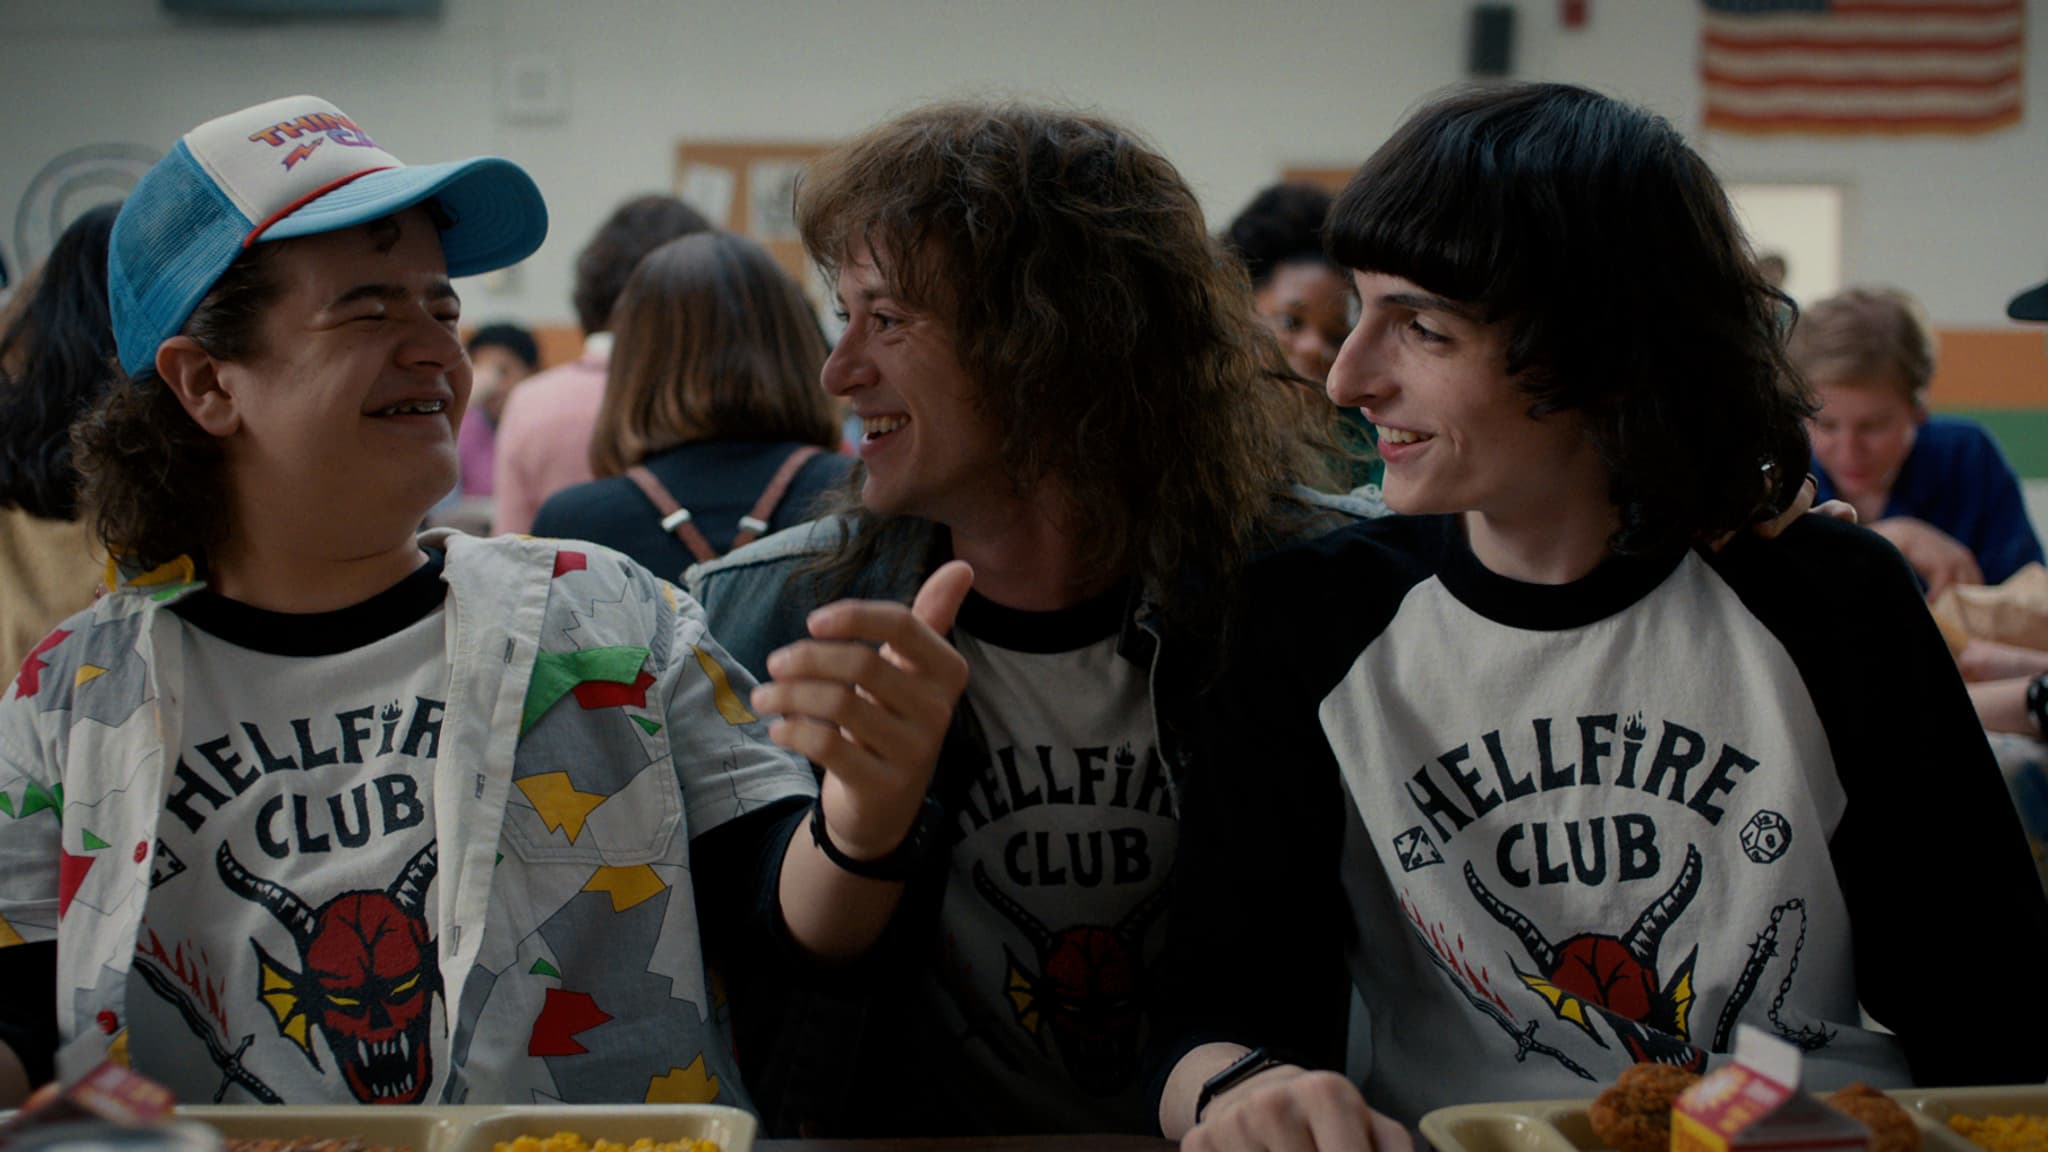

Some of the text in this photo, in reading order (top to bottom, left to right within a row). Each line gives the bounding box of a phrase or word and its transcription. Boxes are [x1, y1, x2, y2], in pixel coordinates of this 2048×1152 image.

[166, 696, 446, 834] HELLFIR
[1404, 710, 1760, 844] HELLFIRE
[256, 773, 425, 859] CLUB
[1005, 828, 1150, 886] CLUB
[1496, 813, 1661, 888] CLUB
